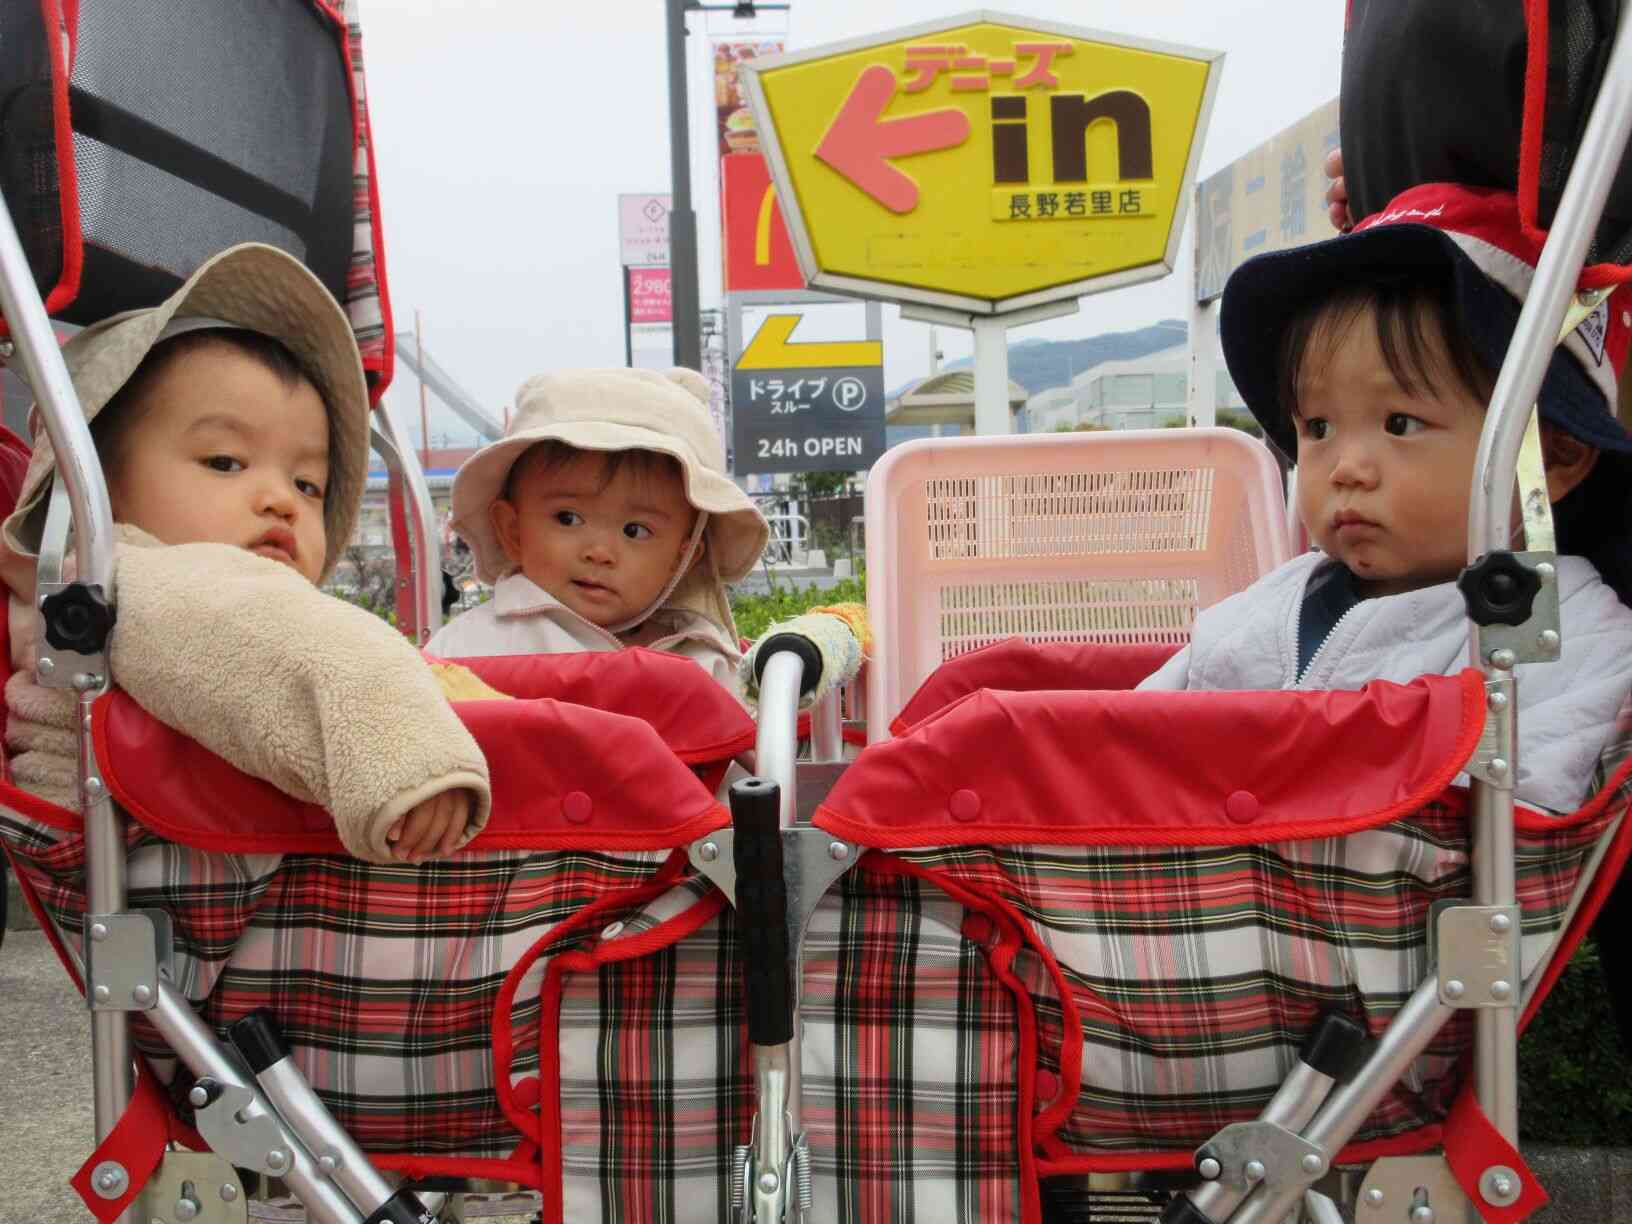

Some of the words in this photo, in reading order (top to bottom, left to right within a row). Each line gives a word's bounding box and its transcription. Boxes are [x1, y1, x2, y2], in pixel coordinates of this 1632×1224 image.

[904, 43, 1074, 93] デニーズ
[991, 90, 1154, 184] in
[1008, 190, 1142, 219] 長野若里店
[749, 376, 828, 401] ドライブ
[770, 400, 811, 415] スルー
[757, 438, 798, 458] 24h
[803, 436, 863, 457] OPEN
